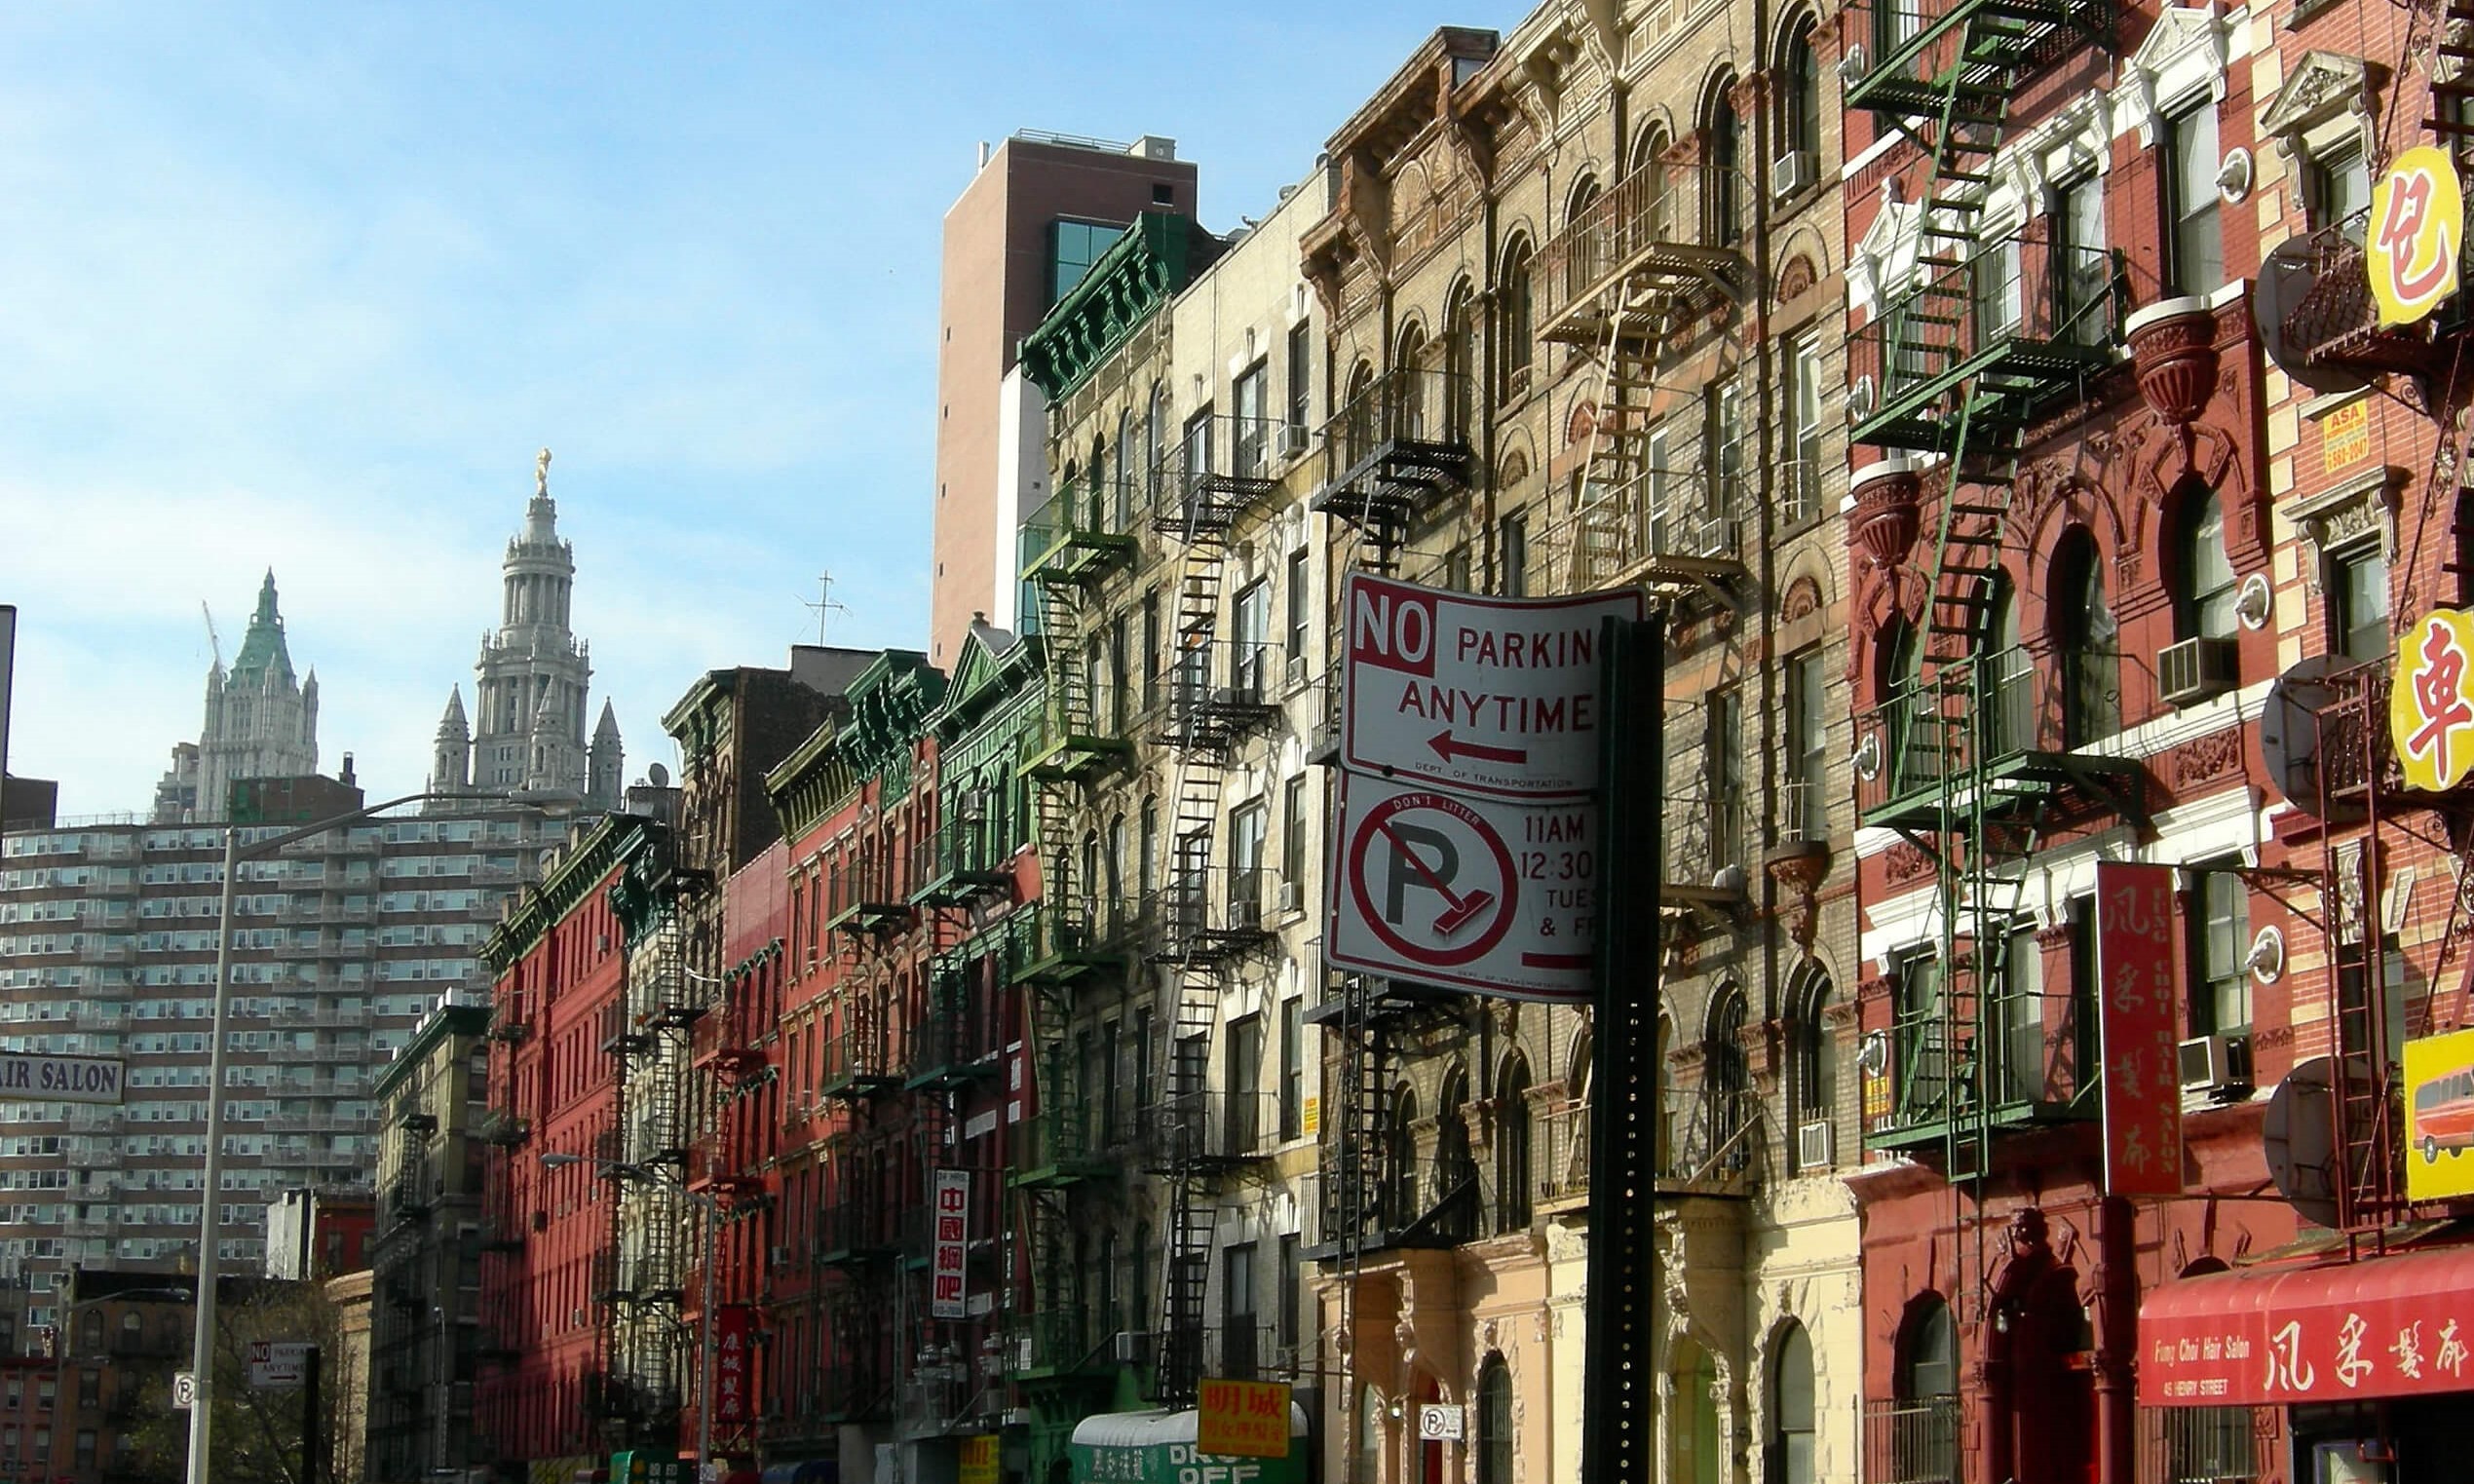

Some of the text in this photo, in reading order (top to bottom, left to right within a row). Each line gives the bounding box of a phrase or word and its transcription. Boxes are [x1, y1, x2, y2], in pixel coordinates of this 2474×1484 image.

[2378, 169, 2452, 302] 包
[2330, 405, 2359, 429] ASA
[1355, 589, 1603, 668] NO PARKIN
[1398, 680, 1593, 734] ANYTIME
[2409, 620, 2473, 784] 車
[1415, 761, 1442, 774] DEPT
[1453, 769, 1466, 779] OF
[1393, 795, 1481, 825] DON'T LITTER
[1525, 814, 1583, 844] 11AM
[1521, 851, 1592, 881] 12:30
[1541, 916, 1556, 936] &
[2155, 1031, 2173, 1085] HAIR
[0, 1060, 117, 1092] IR SALON
[2158, 1102, 2176, 1173] SALON
[252, 1345, 306, 1359] NO PARKIN
[2202, 1336, 2222, 1360] Hair
[2225, 1334, 2250, 1359] Salon
[2199, 1378, 2228, 1395] STREET
[1179, 1465, 1261, 1484] OFF
